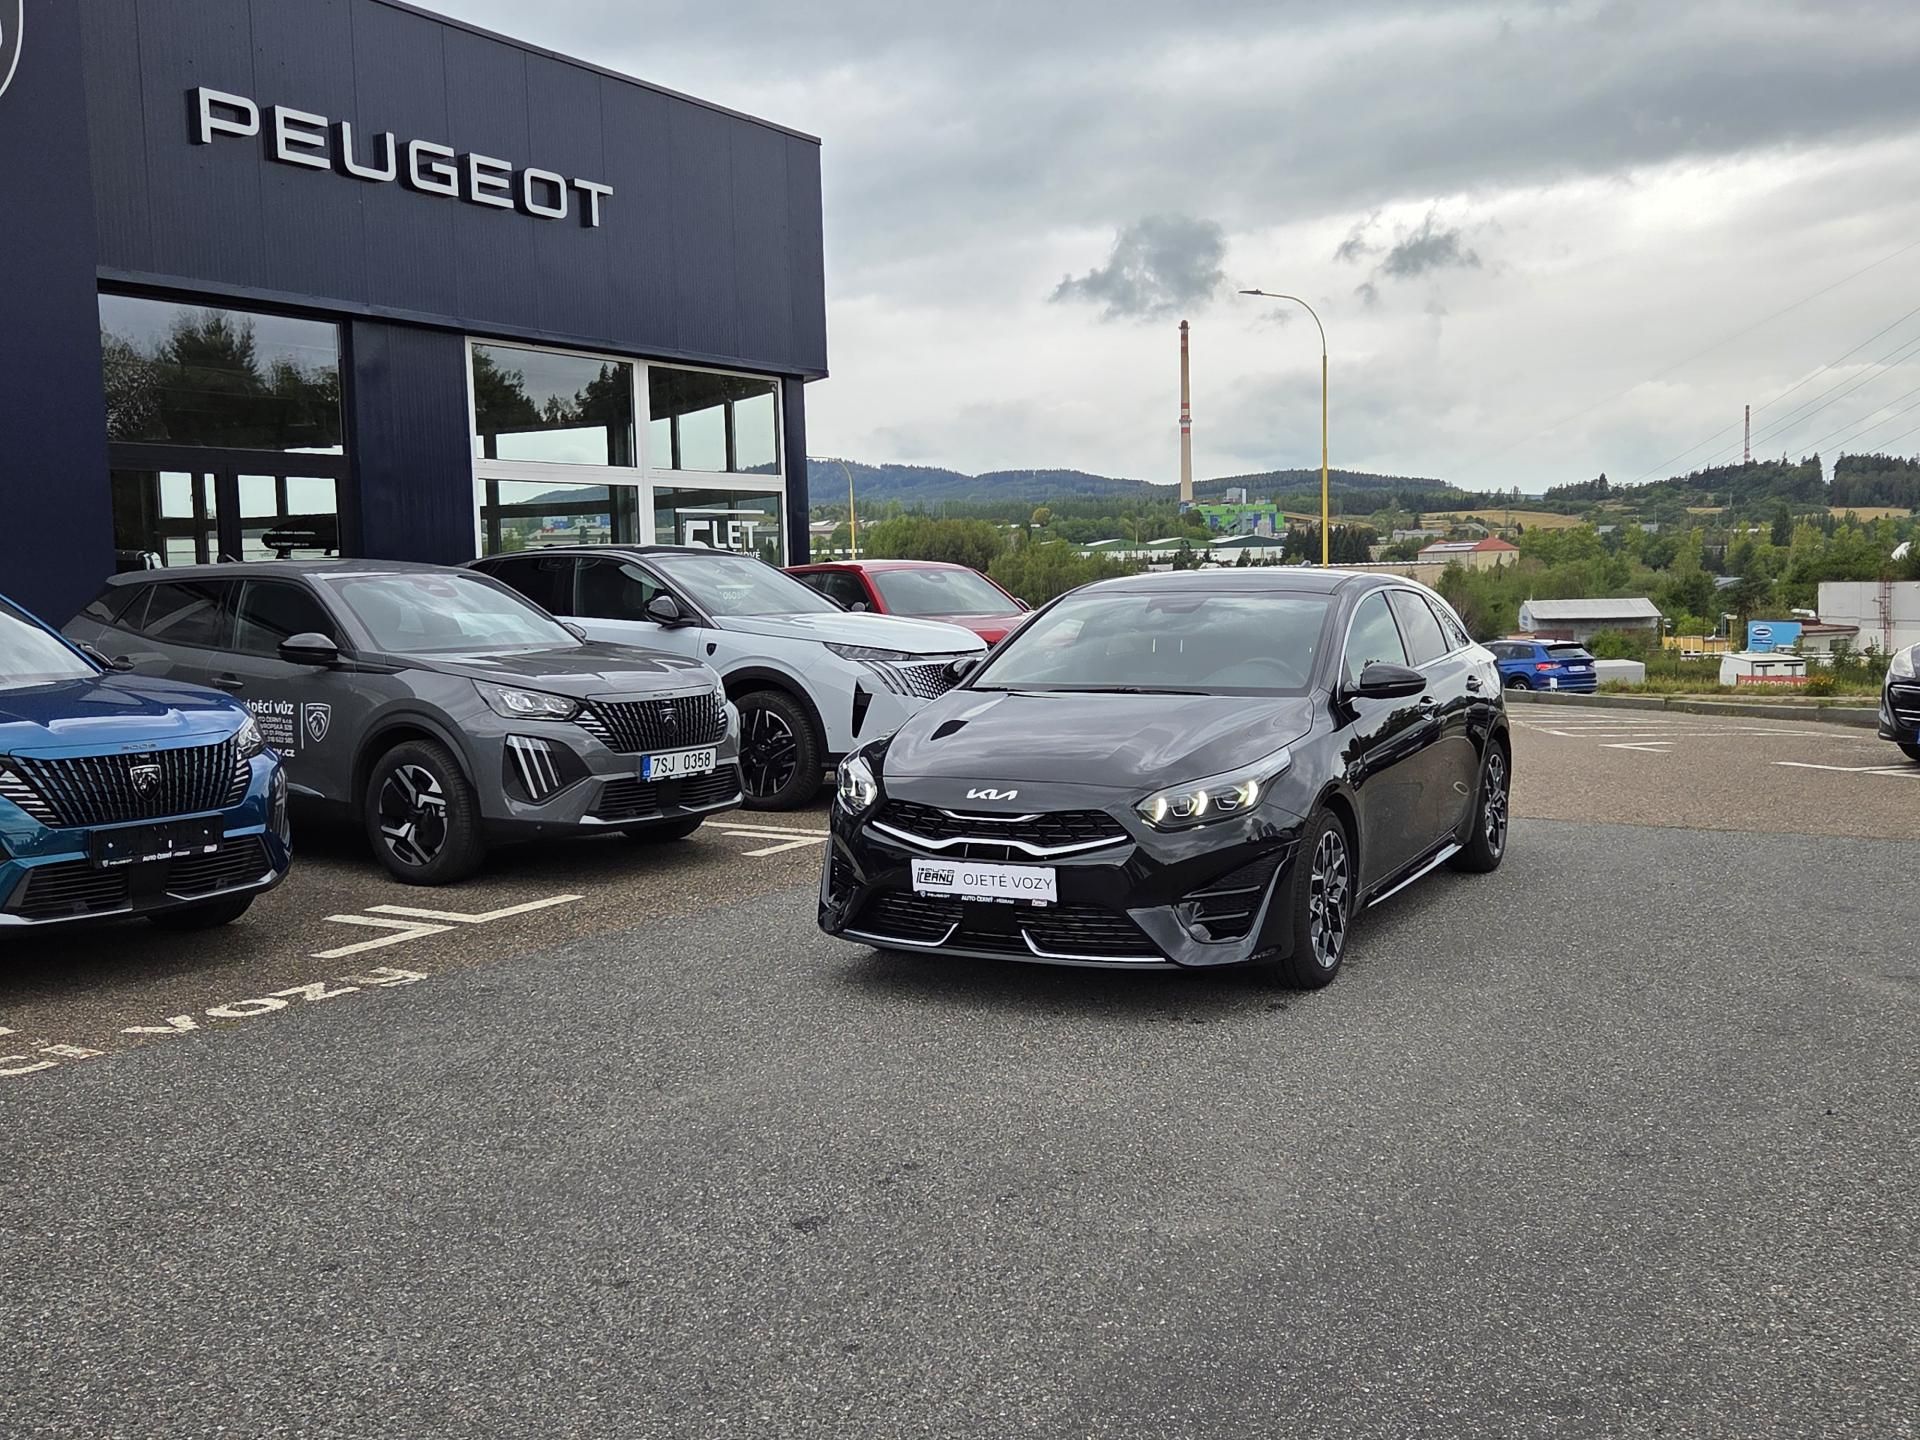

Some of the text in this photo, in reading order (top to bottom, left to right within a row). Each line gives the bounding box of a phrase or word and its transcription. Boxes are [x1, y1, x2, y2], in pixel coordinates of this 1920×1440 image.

[197, 86, 614, 228] PEUGEOT
[711, 520, 761, 549] LET
[274, 700, 294, 715] VŮZ
[653, 756, 675, 775] 7SJ
[684, 751, 711, 770] 0358
[966, 788, 1018, 800] KIA
[963, 873, 1053, 890] OJETÉ VOZY
